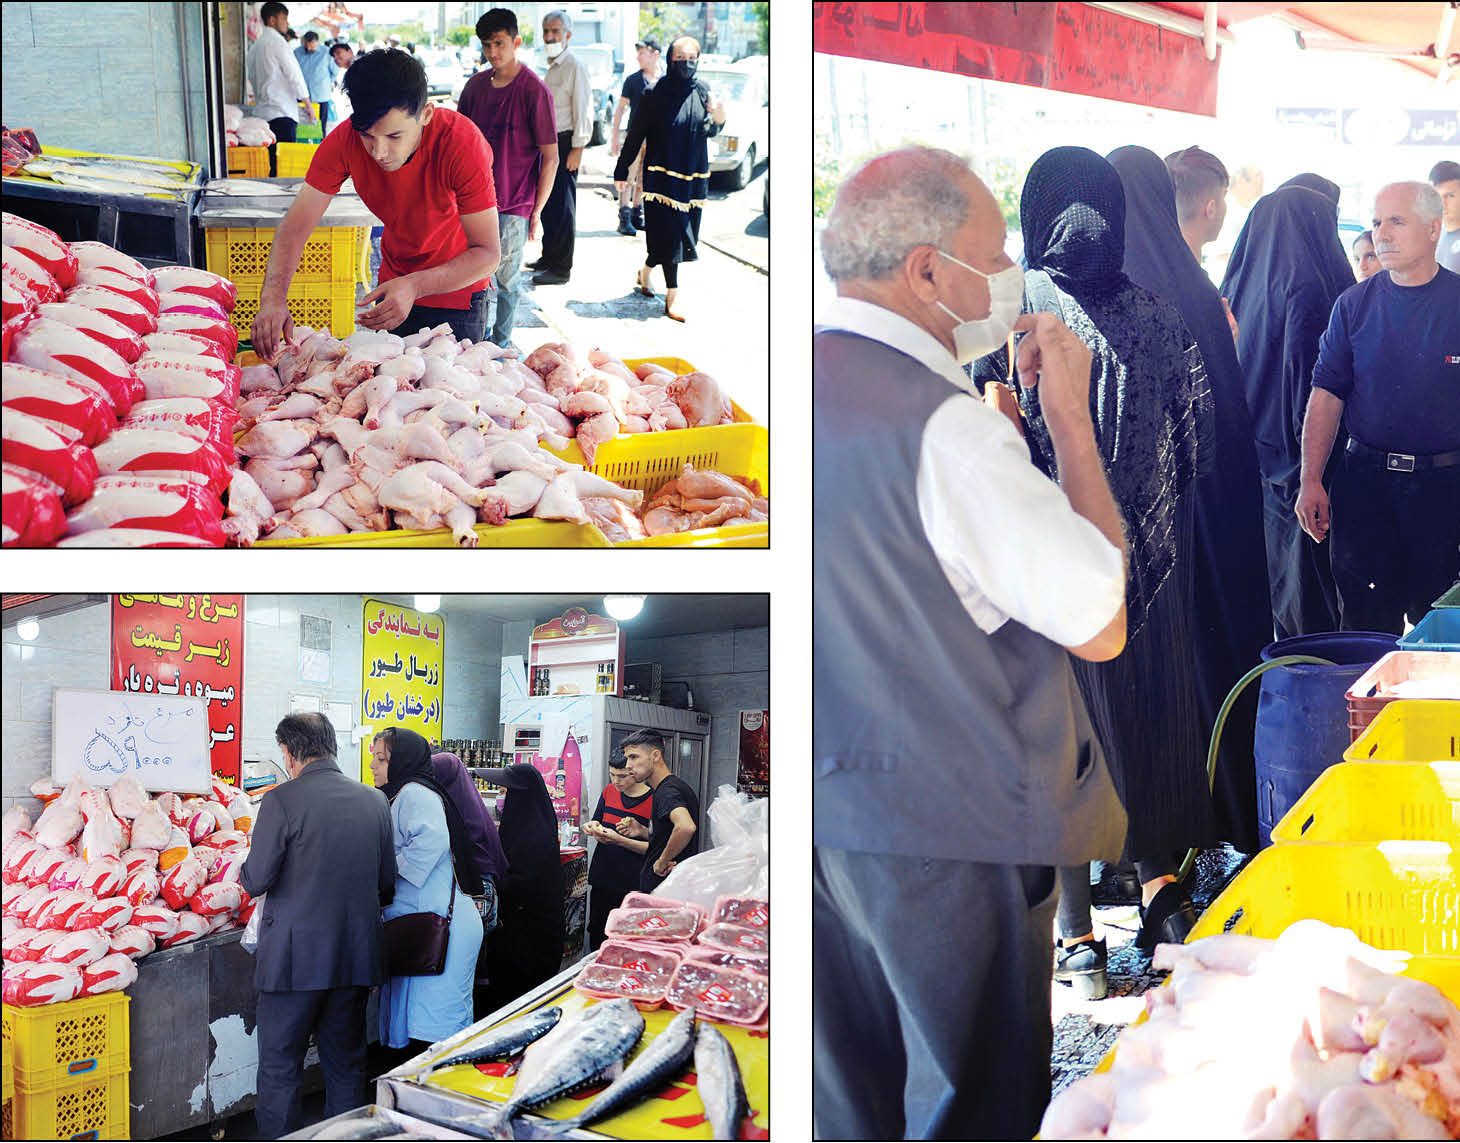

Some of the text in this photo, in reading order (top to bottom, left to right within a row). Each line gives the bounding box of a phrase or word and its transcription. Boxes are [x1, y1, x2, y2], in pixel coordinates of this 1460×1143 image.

[186, 595, 196, 619] و
[367, 608, 440, 646] به نمایندگی
[131, 624, 231, 667] زیر قیمت
[369, 651, 439, 686] زربال طیور
